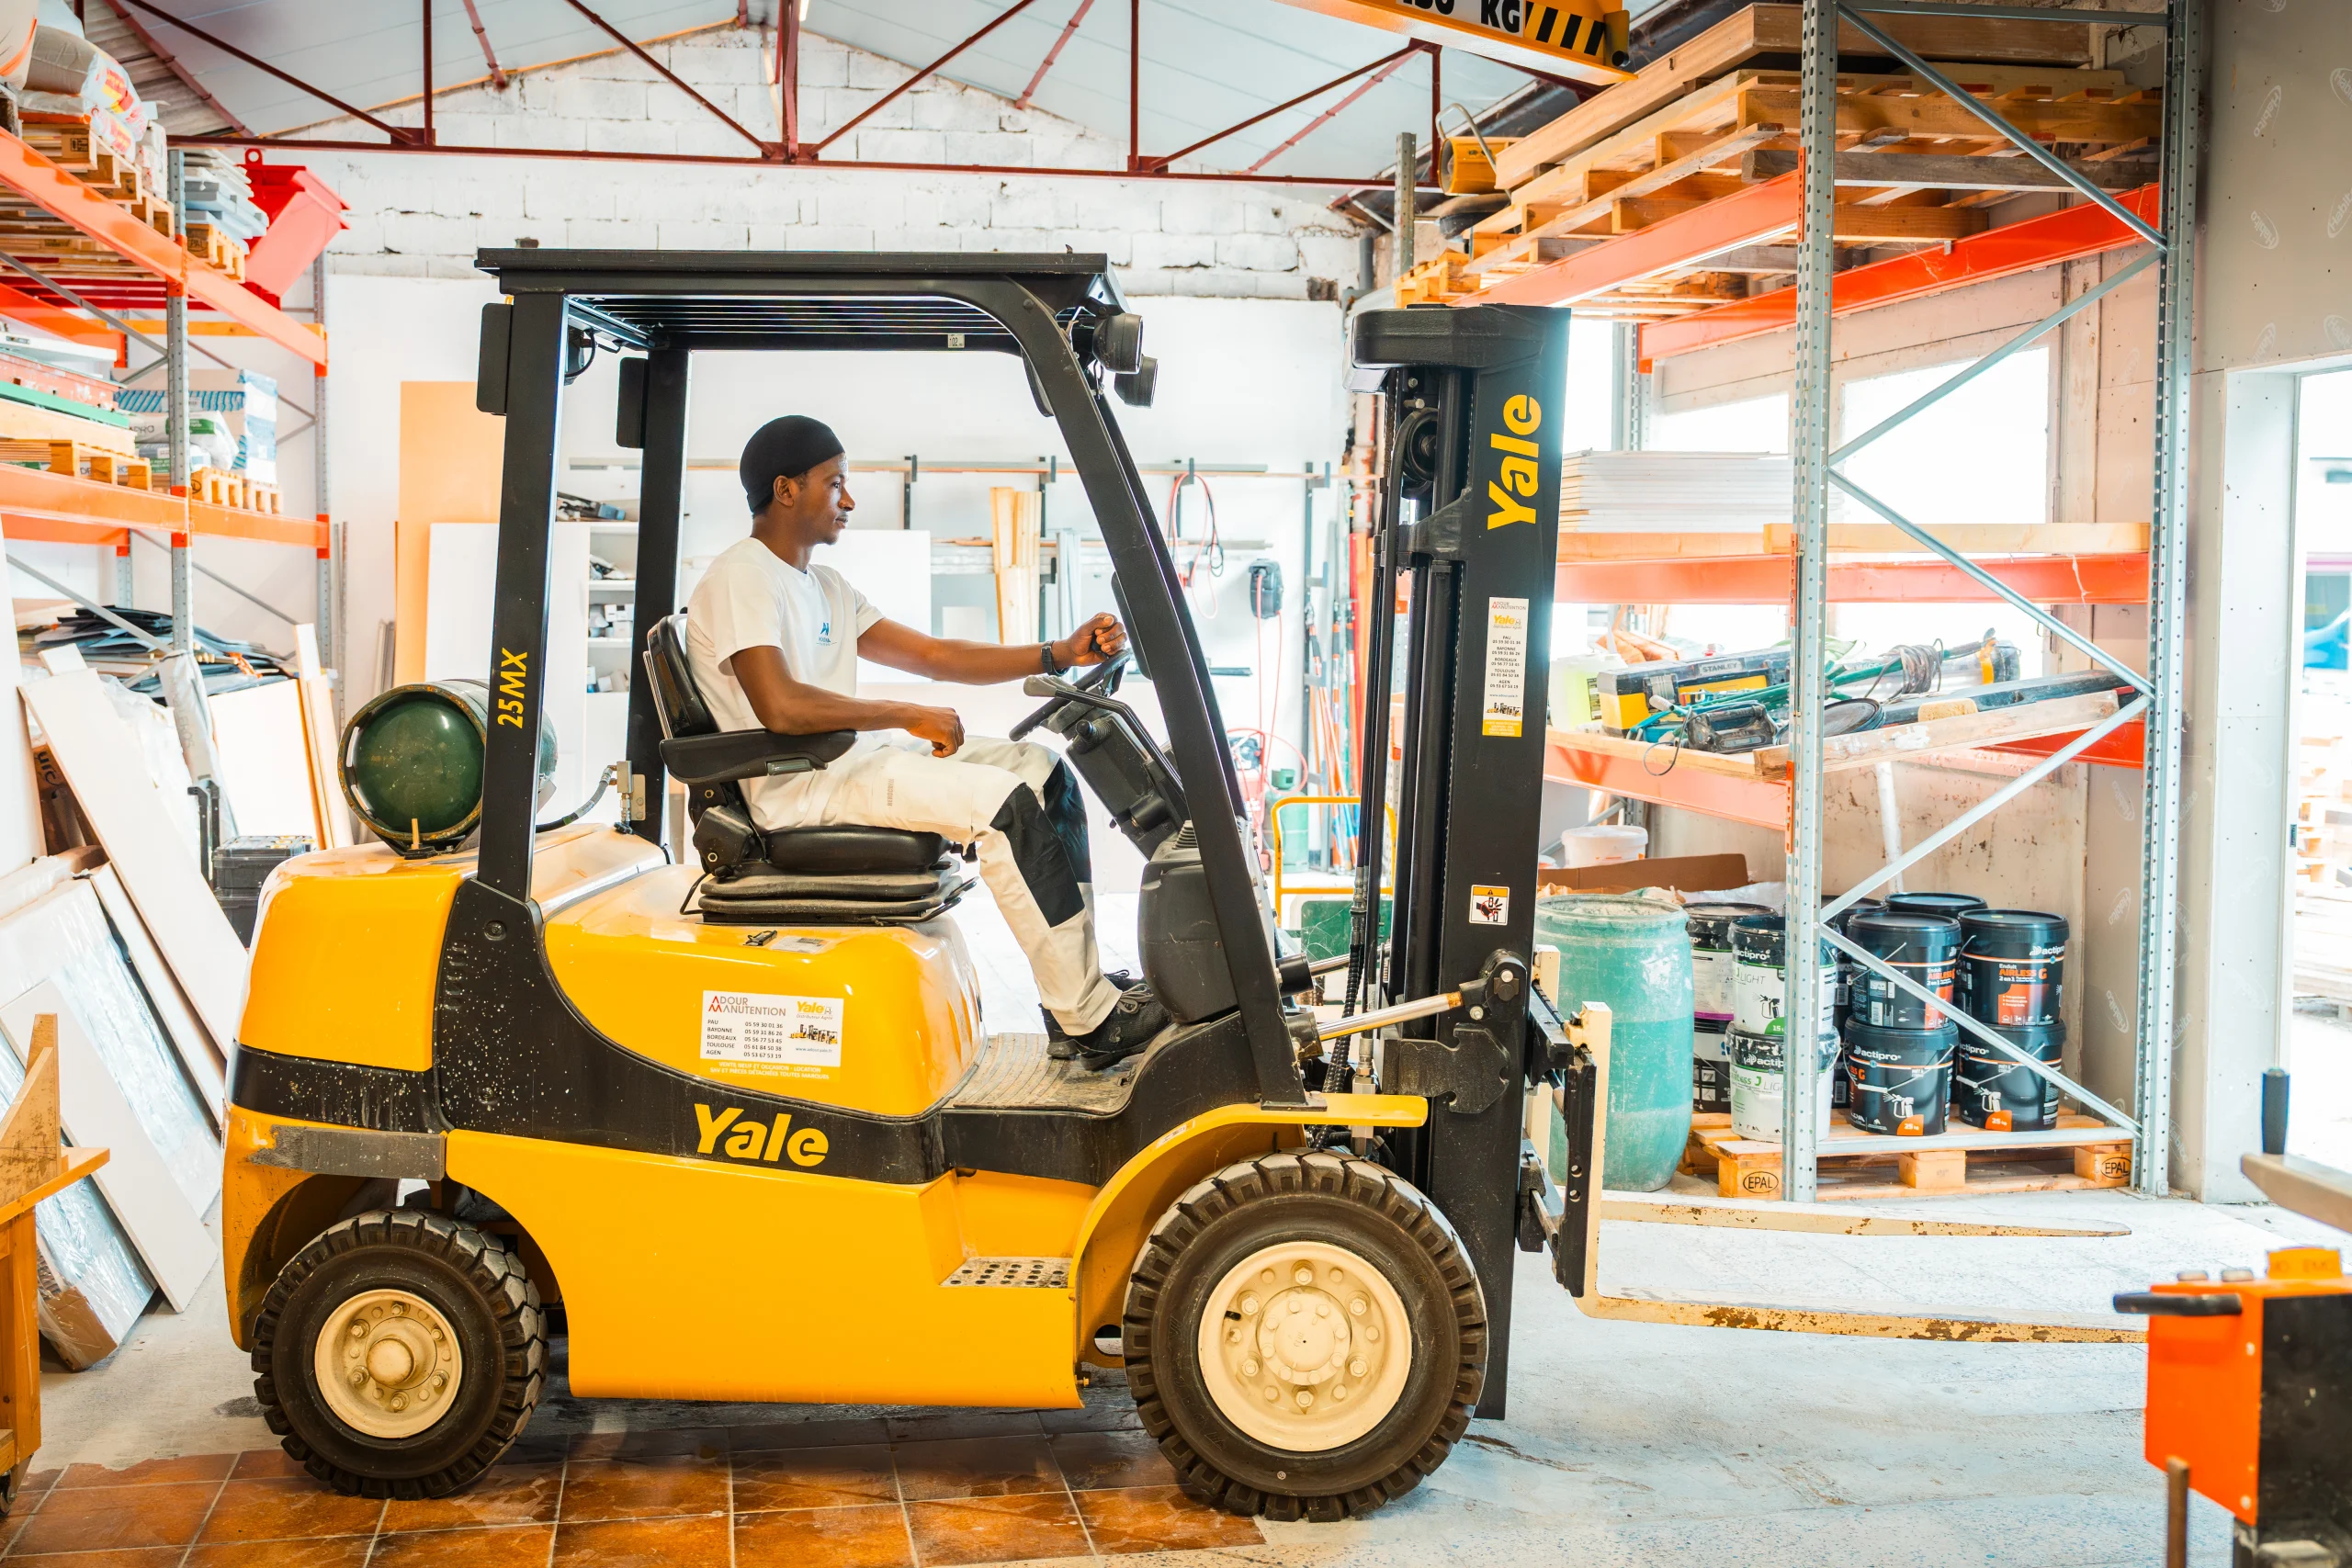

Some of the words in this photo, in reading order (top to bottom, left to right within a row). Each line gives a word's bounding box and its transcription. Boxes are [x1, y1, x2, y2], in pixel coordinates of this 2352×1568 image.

[1481, 0, 1520, 33] KG
[2329, 190, 2352, 231] Habit
[1487, 394, 1542, 530] Yale
[1494, 615, 1515, 624] Yale
[1702, 661, 1737, 672] STANLEY
[497, 647, 528, 728] 25MX
[1740, 974, 1766, 985] LIGHT
[1999, 968, 2037, 976] AIRLESS
[2039, 968, 2047, 979] G
[711, 996, 748, 1006] ADOUR
[797, 1000, 824, 1013] Yale
[708, 1004, 786, 1016] MANUTENTION
[2173, 1013, 2192, 1041] abito
[1860, 1050, 1898, 1061] actipro
[1757, 1058, 1784, 1067] actip
[1858, 1068, 1865, 1080] G
[1755, 1076, 1761, 1087] J
[1763, 1081, 1783, 1091] LIG
[694, 1103, 829, 1167] Yale
[2105, 1161, 2129, 1174] EPAL
[1747, 1176, 1773, 1190] EPAL
